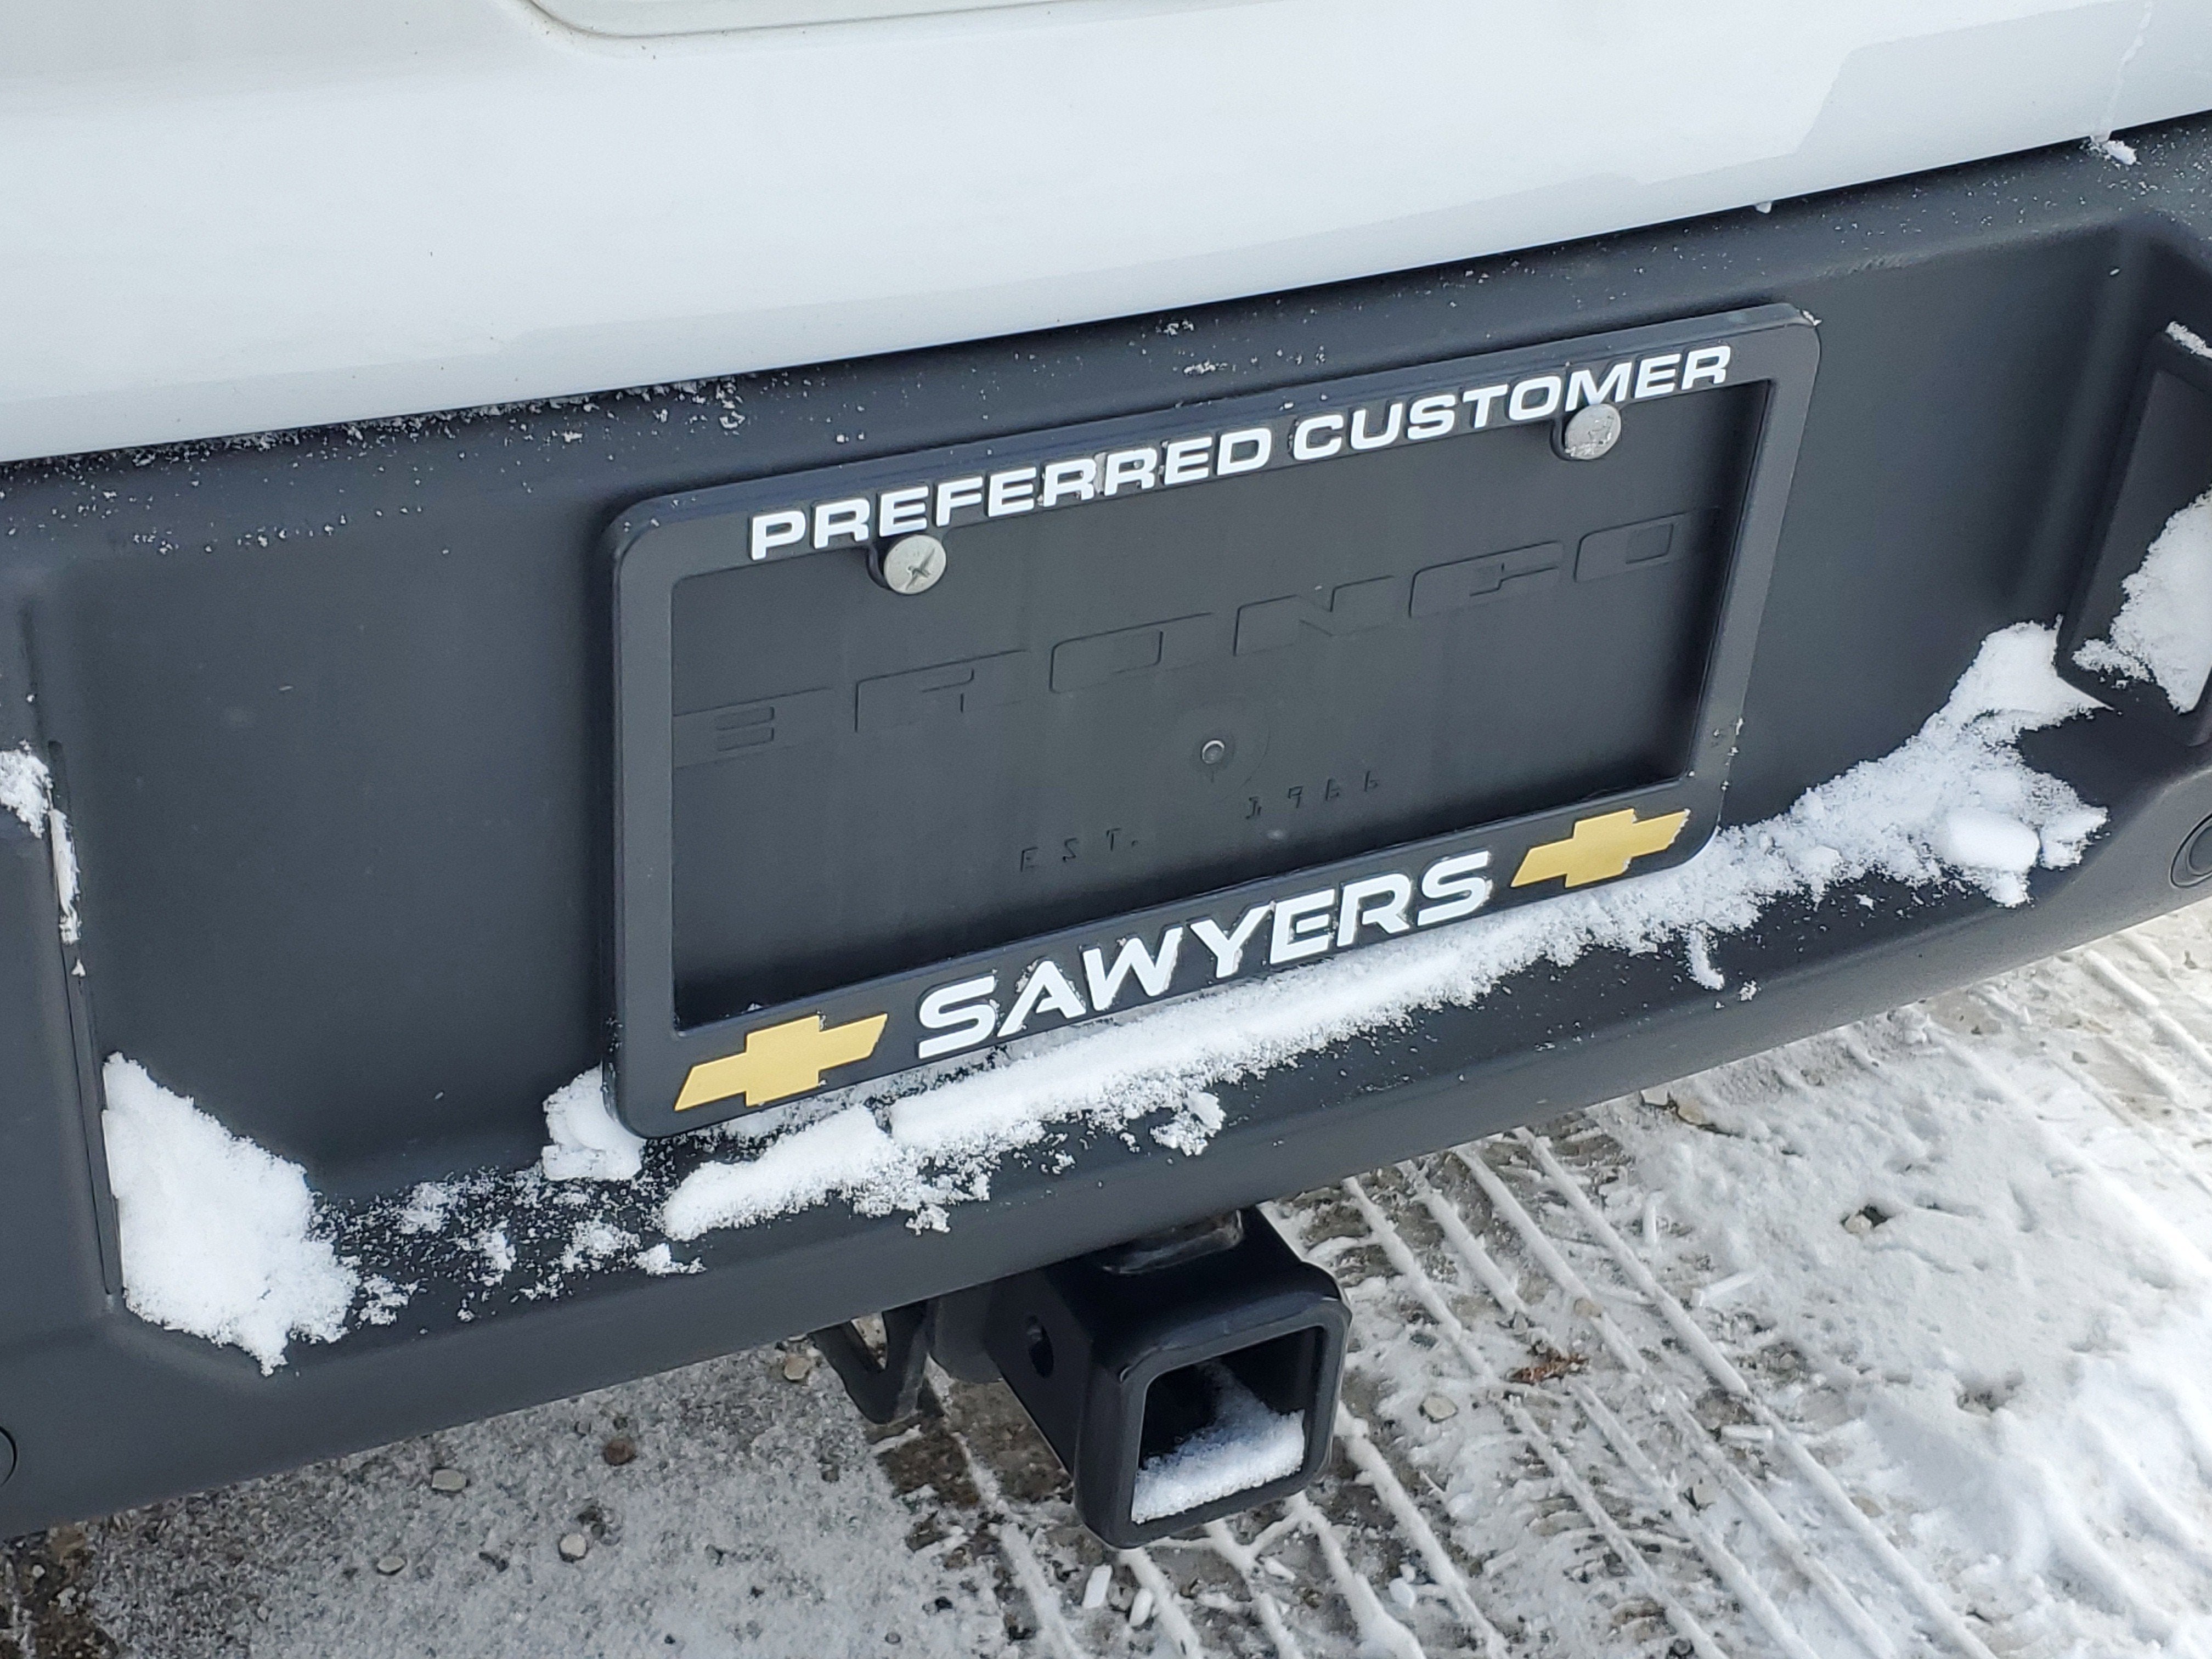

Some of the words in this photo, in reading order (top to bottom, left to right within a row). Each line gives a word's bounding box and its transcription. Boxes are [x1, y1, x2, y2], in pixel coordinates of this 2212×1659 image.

[749, 424, 1273, 562] PREFERRED
[1291, 345, 1731, 462] CUSTOMER
[673, 505, 1722, 769] BRONCO
[1019, 827, 1140, 872] EST.
[1245, 770, 1379, 820] 1966
[917, 850, 1492, 1059] SAWYERS
